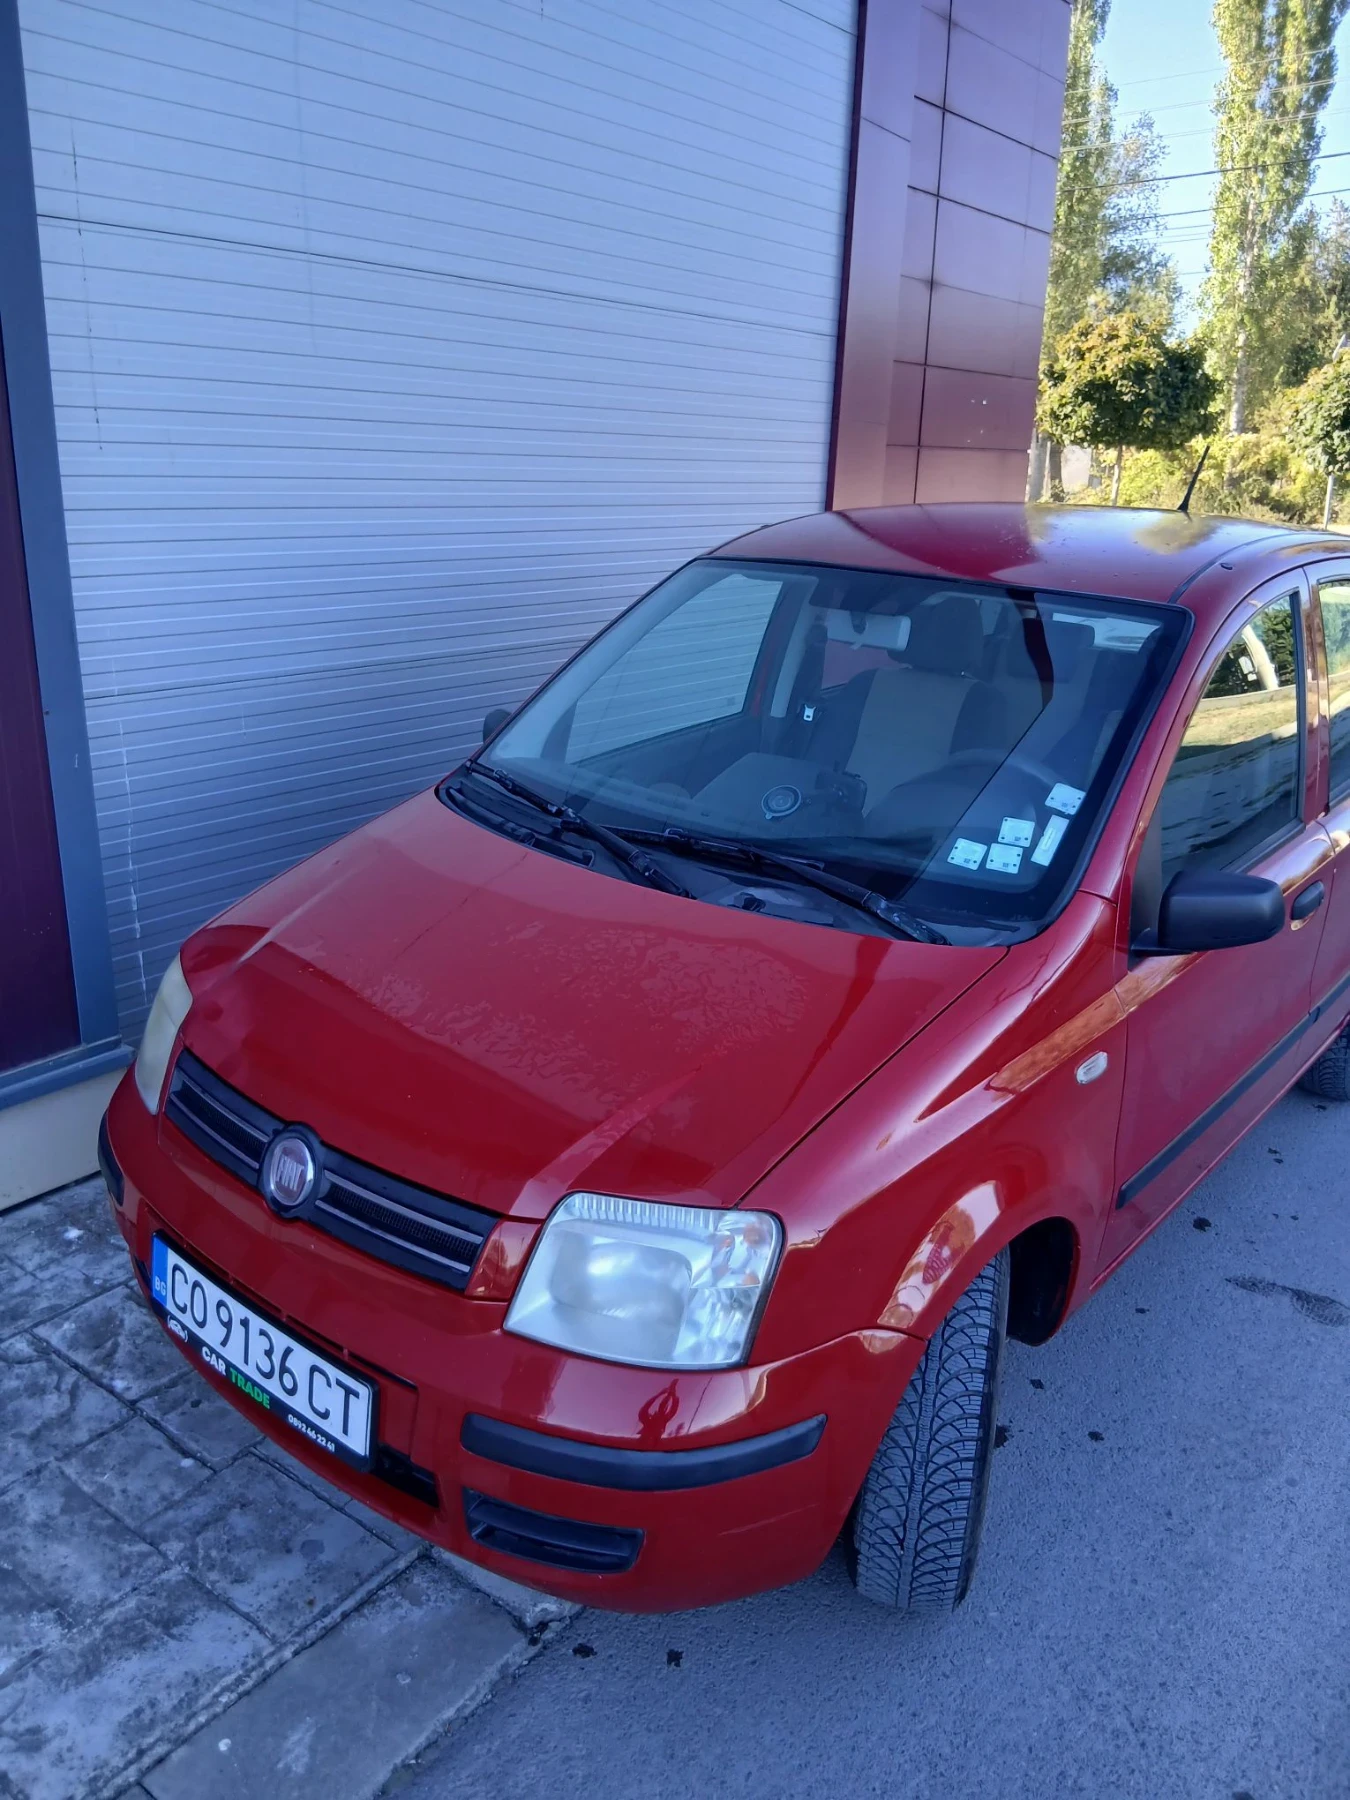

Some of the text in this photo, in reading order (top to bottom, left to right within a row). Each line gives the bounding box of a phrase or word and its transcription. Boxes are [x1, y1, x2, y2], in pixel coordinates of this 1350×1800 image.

[275, 1154, 305, 1192] FIAT
[154, 1275, 167, 1296] BG
[201, 1346, 271, 1409] CAR TRADE
